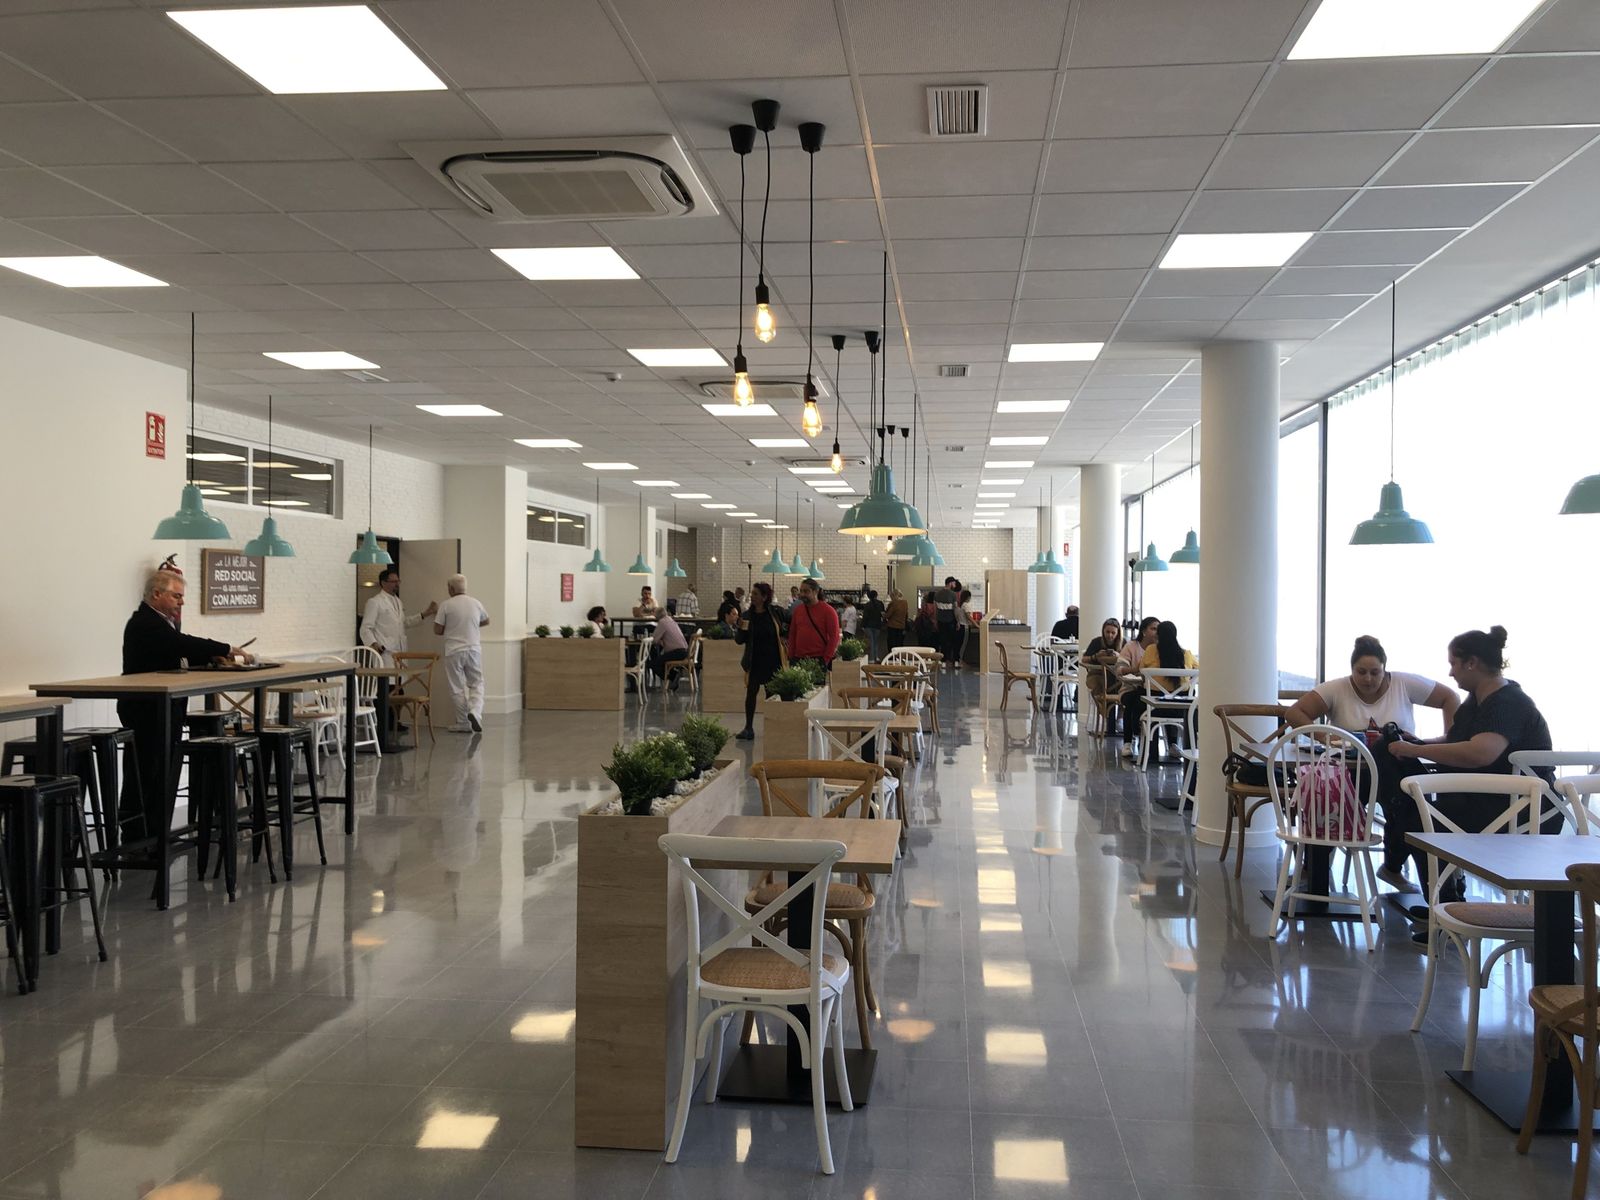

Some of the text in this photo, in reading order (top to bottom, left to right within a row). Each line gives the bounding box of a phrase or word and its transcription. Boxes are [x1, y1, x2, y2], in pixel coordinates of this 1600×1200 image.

[214, 569, 256, 582] RED SOCIAL
[212, 594, 257, 606] CON AMIGOS
